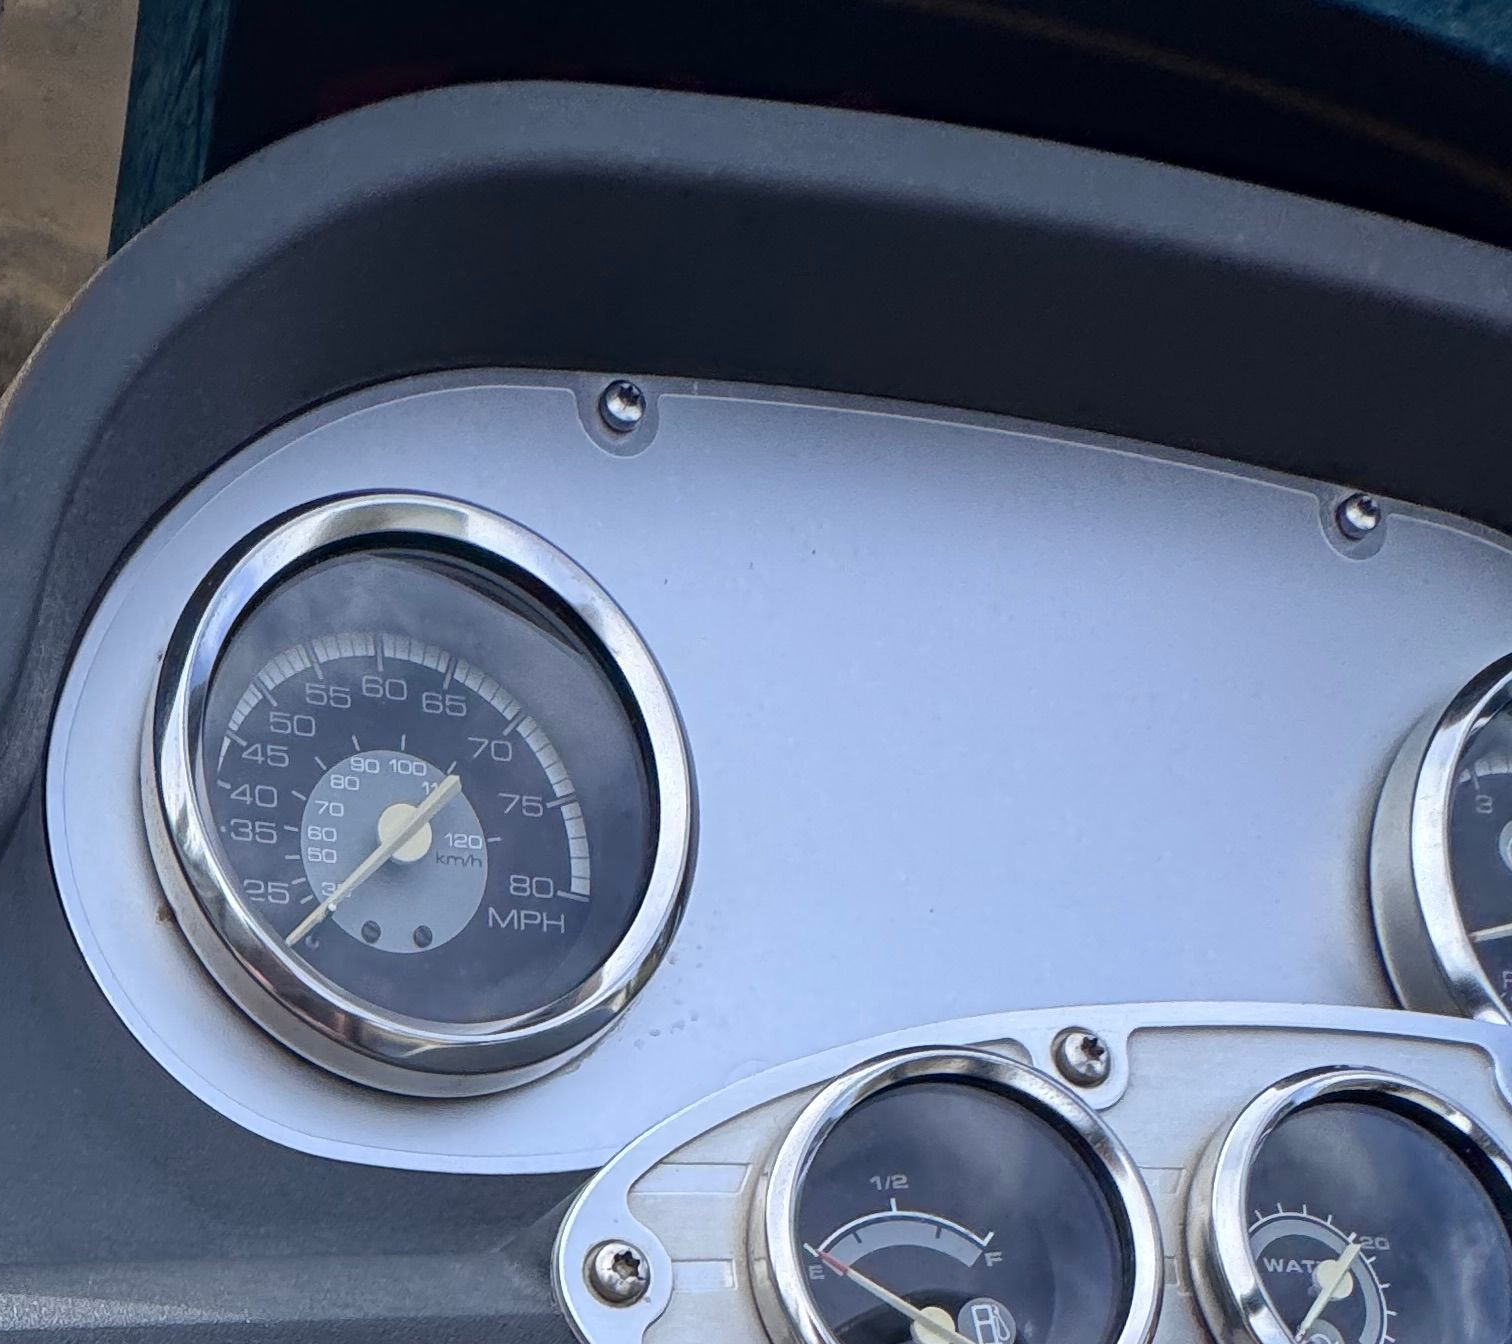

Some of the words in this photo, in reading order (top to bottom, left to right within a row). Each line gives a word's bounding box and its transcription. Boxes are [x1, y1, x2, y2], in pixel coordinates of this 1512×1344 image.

[304, 682, 352, 709] 55
[361, 674, 408, 701] 60
[421, 691, 468, 717] 65
[268, 711, 317, 738] 50
[240, 743, 290, 768] 45
[467, 736, 514, 762] 70
[349, 756, 381, 774] 90
[388, 758, 428, 777] 100
[329, 773, 361, 792] 80
[229, 783, 279, 809] 40
[497, 792, 544, 818] 75
[314, 800, 345, 817] 70
[229, 818, 279, 845] 35
[306, 825, 338, 843] 60
[443, 831, 484, 850] 120
[306, 847, 338, 864] 50
[435, 851, 483, 869] km/h
[242, 879, 291, 905] 25
[508, 874, 555, 899] 80
[487, 907, 566, 934] MPH
[868, 1174, 910, 1192] 1/2
[1358, 1235, 1391, 1251] 20
[985, 1251, 1003, 1267] F
[1262, 1256, 1322, 1274] WAT
[808, 1264, 825, 1281] E
